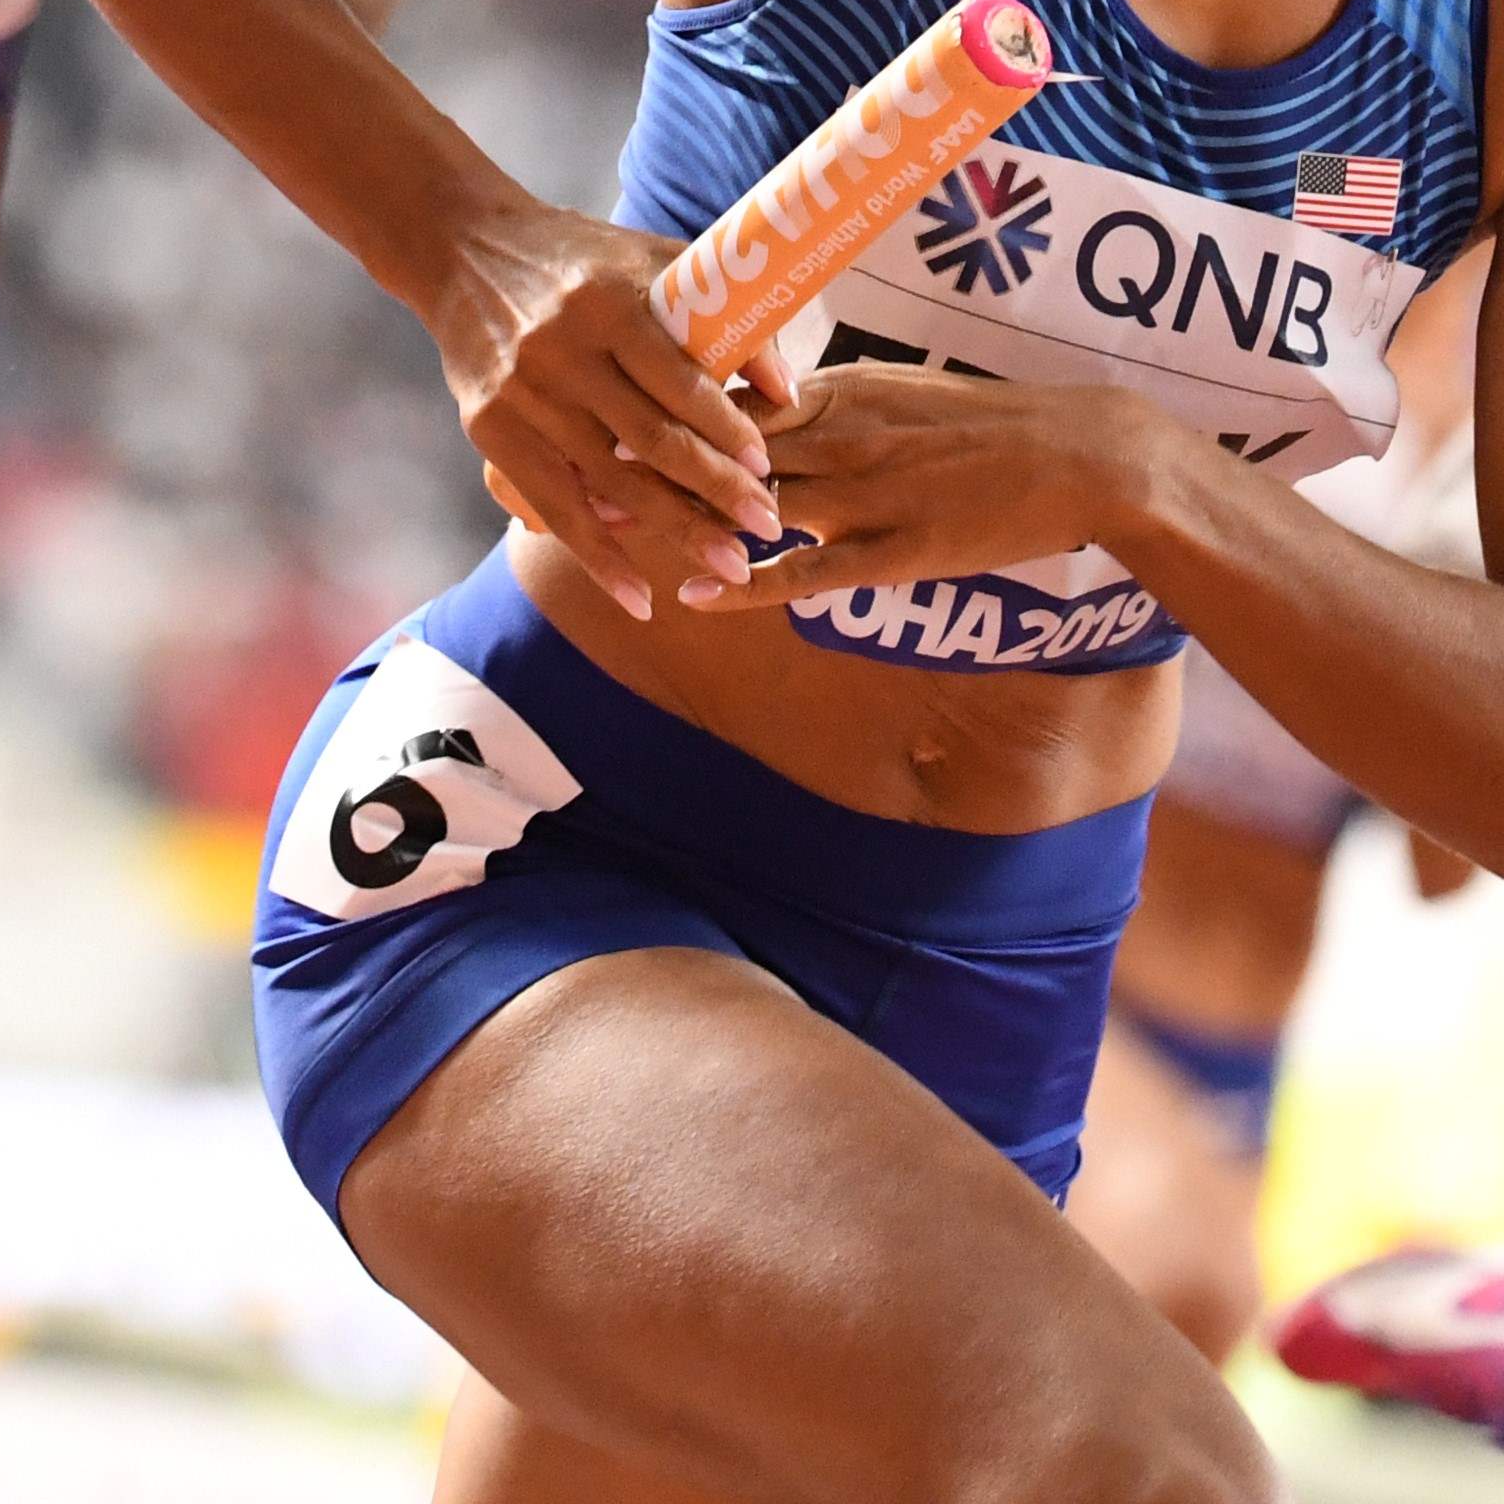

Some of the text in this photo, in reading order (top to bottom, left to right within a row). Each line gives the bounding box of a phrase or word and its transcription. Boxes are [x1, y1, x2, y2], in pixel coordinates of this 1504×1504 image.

[927, 107, 986, 165] IAAF
[649, 36, 956, 346] DOHA201
[863, 158, 931, 218] World
[791, 210, 872, 288] Athletics
[1075, 210, 1333, 368] QNB
[698, 267, 796, 370] Champion
[329, 728, 487, 889] 6
